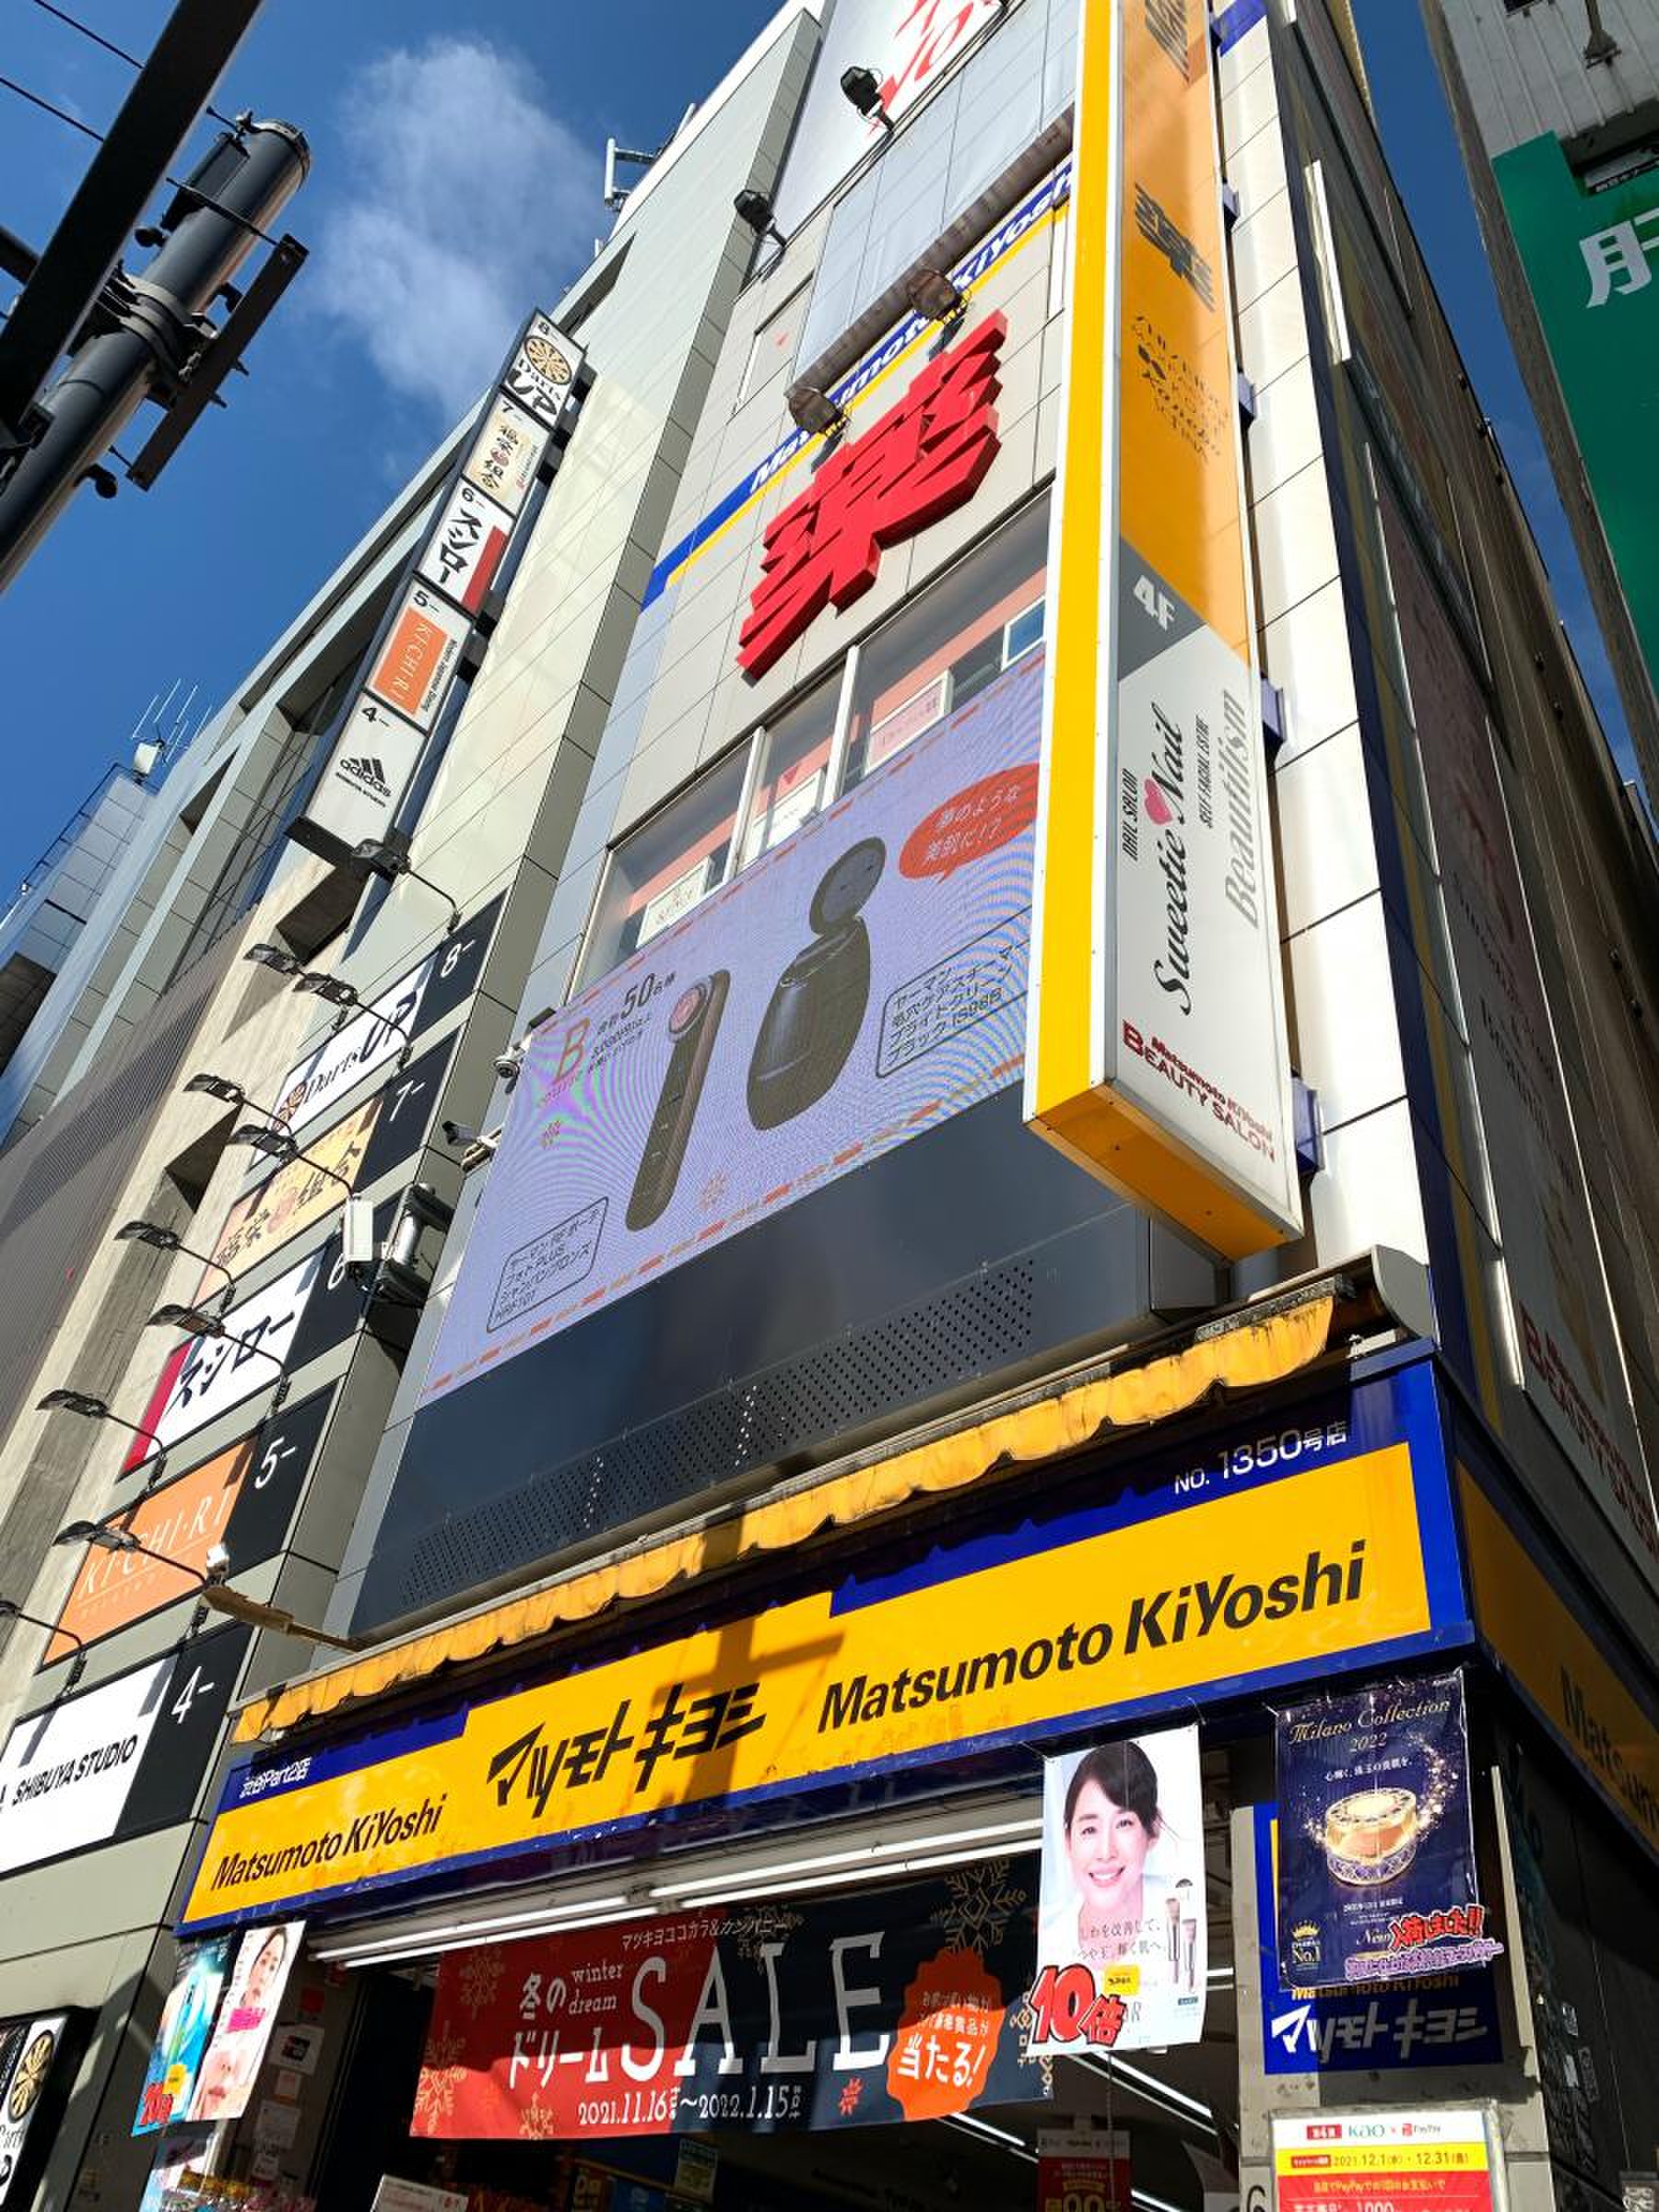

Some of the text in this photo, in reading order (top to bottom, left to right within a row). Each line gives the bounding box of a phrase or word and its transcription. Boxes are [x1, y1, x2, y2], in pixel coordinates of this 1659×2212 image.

[462, 487, 475, 502] 6
[736, 310, 1007, 681] 薬
[439, 509, 483, 584] スシロー
[413, 590, 429, 608] 5
[1134, 574, 1176, 632] 4F
[361, 707, 378, 724] 4
[339, 758, 392, 797] adidas
[1150, 700, 1192, 1016] Sweetie Nail
[1123, 1018, 1276, 1163] BEAUTY SALON
[163, 1312, 295, 1419] スシロー
[1173, 1420, 1348, 1494] NO. 1350号店
[817, 1537, 1366, 1734] Matsumoto KiYoshi
[487, 1682, 767, 1819] マツモトキヨシ
[1288, 1698, 1452, 1746] Milano Collection
[1350, 1731, 1388, 1753] 2022
[12, 1759, 76, 1806] SHIBUYA
[74, 1733, 138, 1783] STUDIO
[210, 1794, 449, 1892] Matsumoto KiYoshi
[519, 1971, 568, 2020] 冬の
[568, 1987, 618, 2016] dream
[571, 1960, 625, 1984] winter
[619, 1930, 890, 2082] SALE
[1030, 1964, 1126, 2048] 10倍
[509, 2026, 610, 2090] ドリーム
[898, 2032, 986, 2088] 当たる!
[1271, 1997, 1487, 2065] マツモトキヨシ
